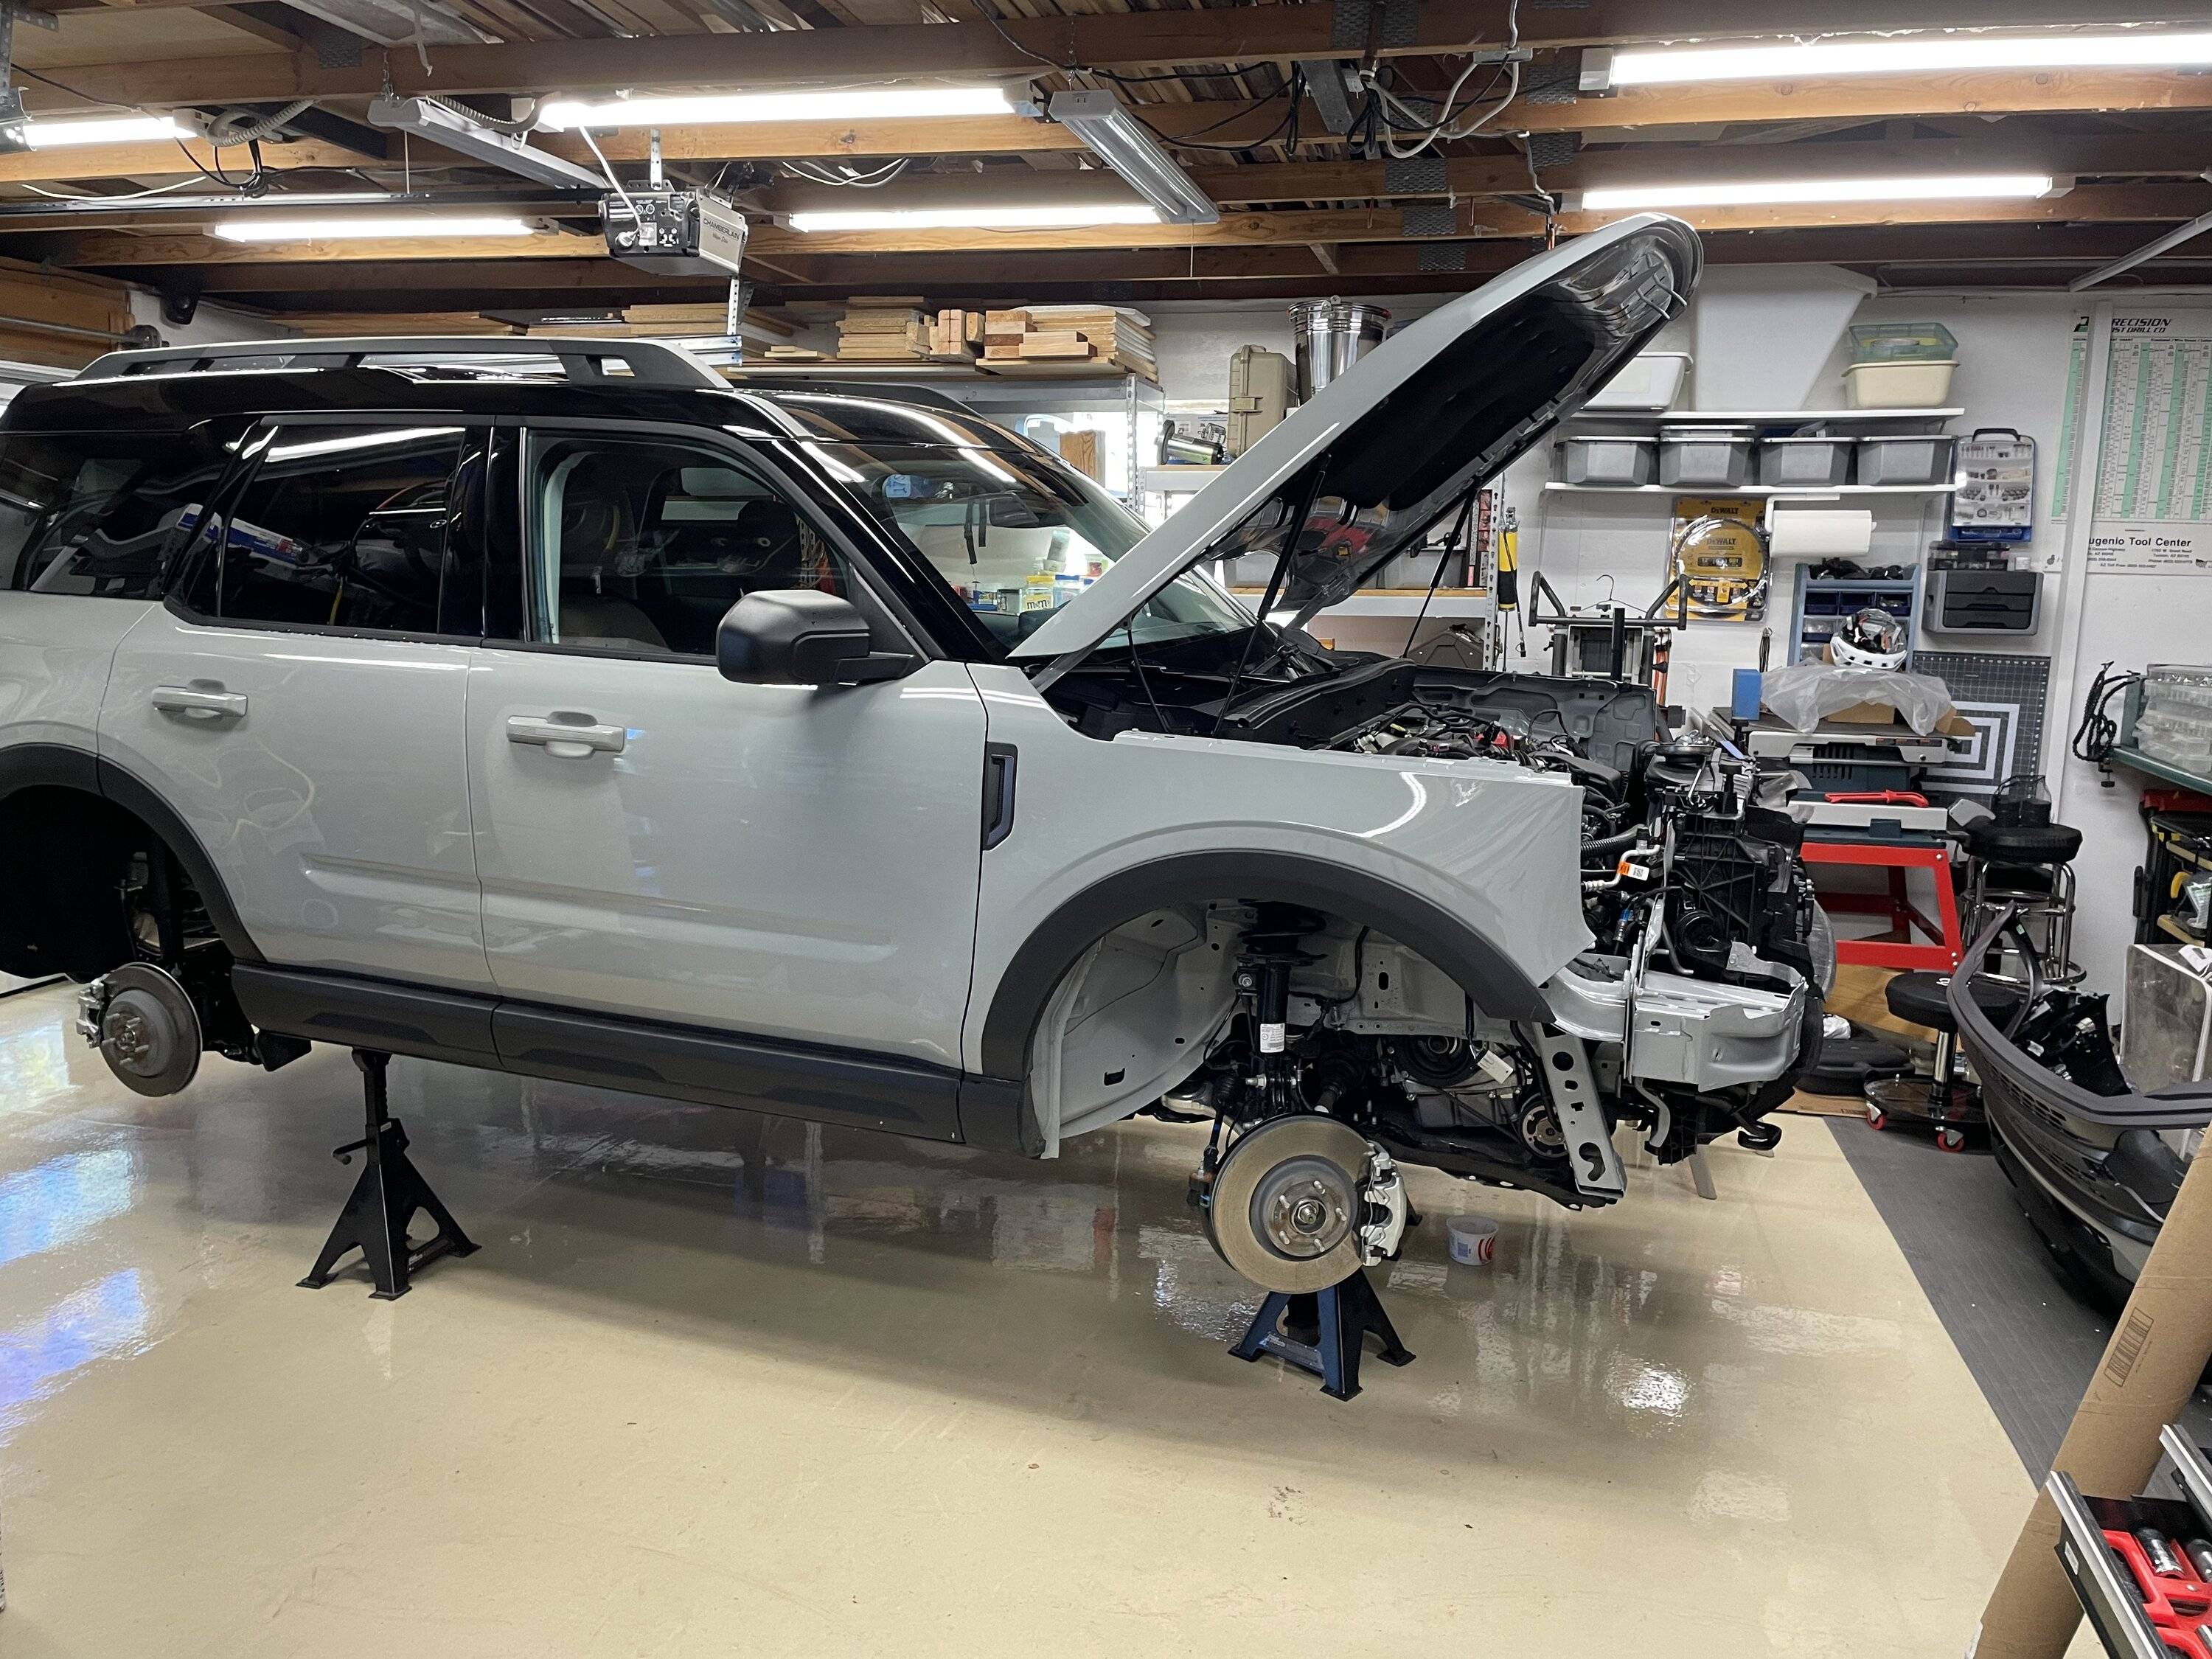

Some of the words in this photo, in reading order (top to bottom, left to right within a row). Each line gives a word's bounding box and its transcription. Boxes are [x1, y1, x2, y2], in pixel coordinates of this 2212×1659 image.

[2089, 537, 2125, 546] ugenio
[2129, 537, 2152, 546] Tool
[2155, 538, 2191, 547] Center
